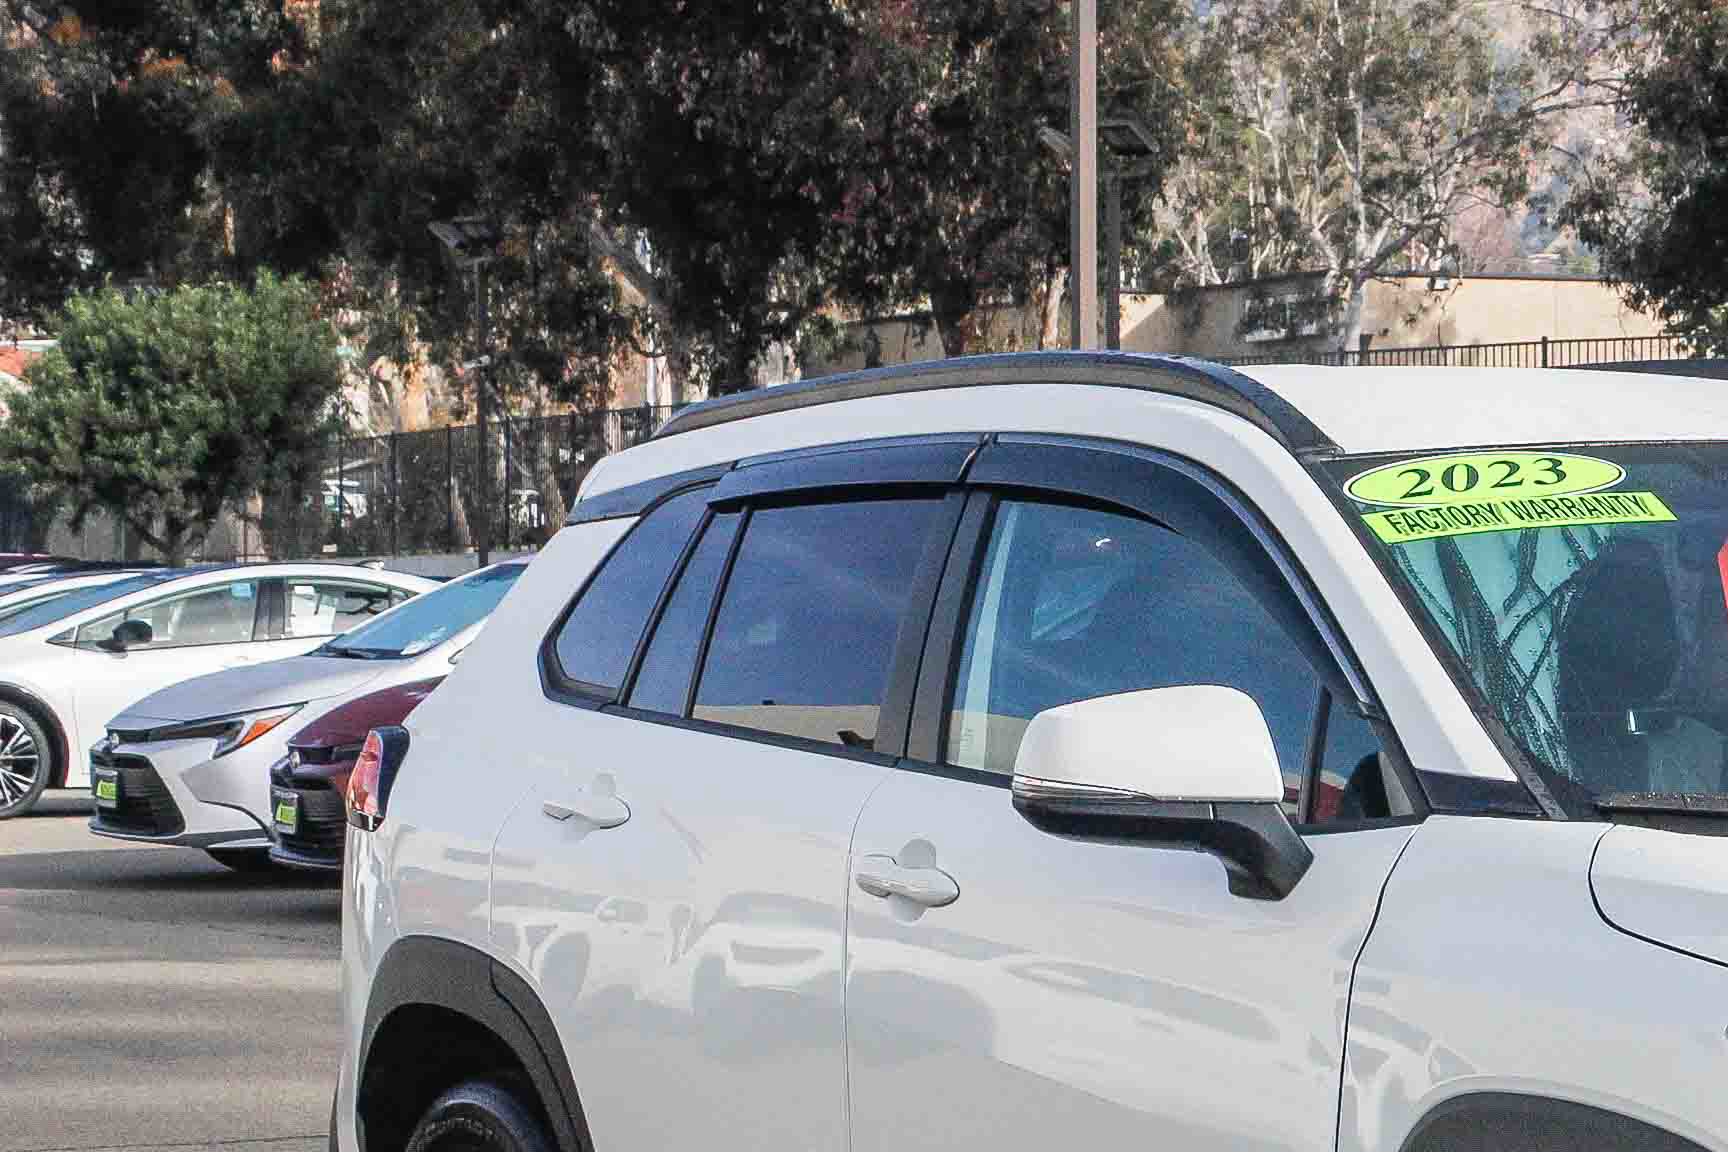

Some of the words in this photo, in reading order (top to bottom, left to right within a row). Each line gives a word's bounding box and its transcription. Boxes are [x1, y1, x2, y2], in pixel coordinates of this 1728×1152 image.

[1397, 457, 1567, 499] 2023
[1383, 502, 1502, 535] FACTORY
[1511, 494, 1649, 524] WARRANTY
